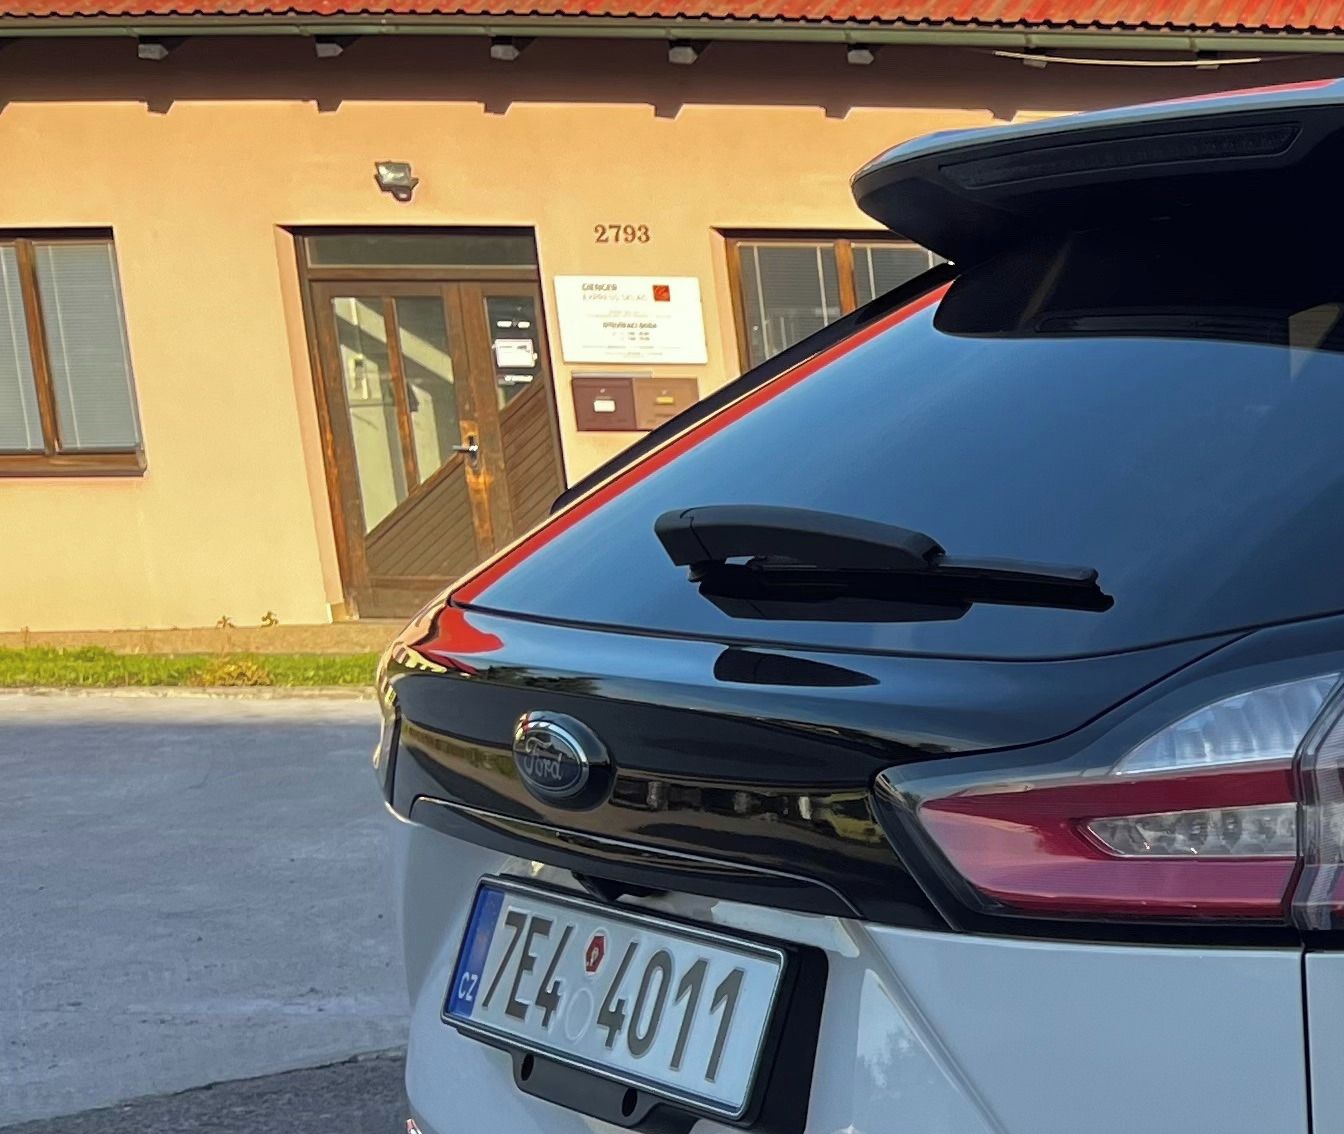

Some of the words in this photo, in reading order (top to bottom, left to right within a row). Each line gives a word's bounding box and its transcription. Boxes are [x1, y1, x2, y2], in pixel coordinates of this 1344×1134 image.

[593, 223, 651, 244] 2793
[524, 736, 563, 781] Ford
[457, 971, 479, 1001] CZ
[481, 909, 574, 1028] 7E4
[596, 940, 745, 1082] 4011
